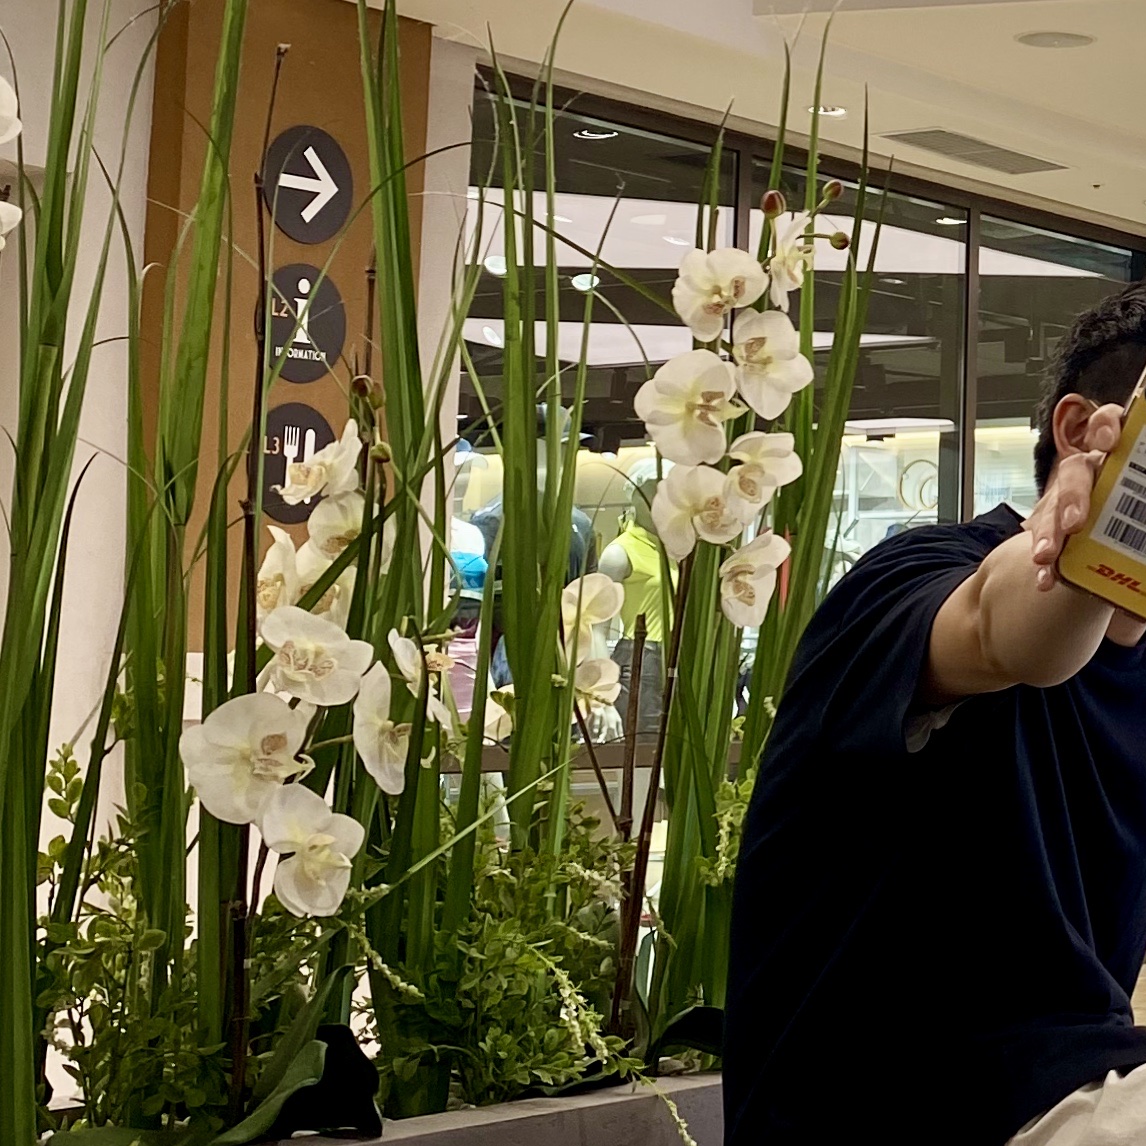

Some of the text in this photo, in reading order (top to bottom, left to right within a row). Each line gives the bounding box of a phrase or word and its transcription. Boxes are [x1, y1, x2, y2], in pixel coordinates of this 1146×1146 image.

[271, 298, 289, 317] L2
[275, 346, 326, 362] INORMATION
[1096, 564, 1141, 592] DHL
